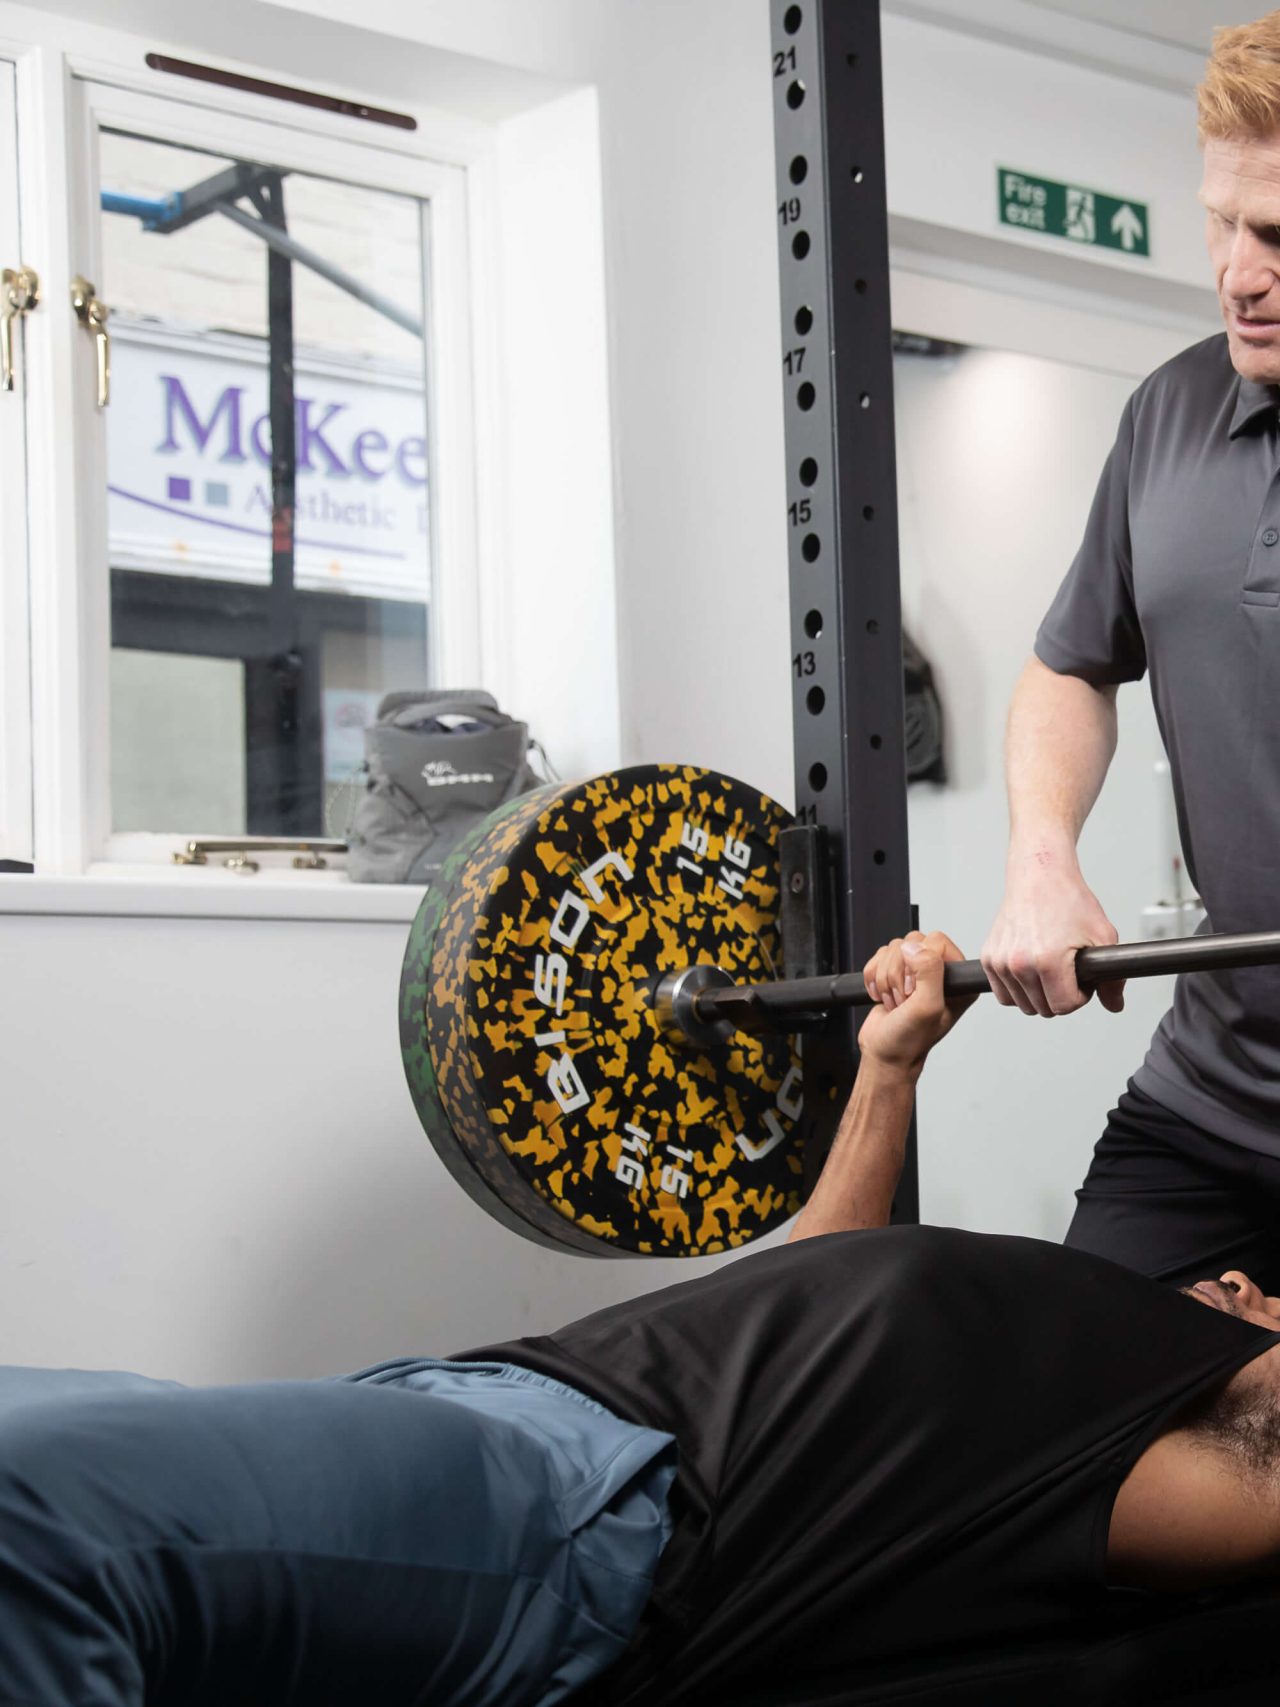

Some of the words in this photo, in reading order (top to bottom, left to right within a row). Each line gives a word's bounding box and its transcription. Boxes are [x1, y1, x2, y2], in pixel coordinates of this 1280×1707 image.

[773, 46, 797, 77] 21
[1004, 173, 1047, 206] Fire
[778, 197, 801, 226] 19
[1005, 202, 1046, 230] exit
[784, 346, 806, 376] 17
[788, 498, 812, 527] 15
[792, 651, 816, 678] 13
[676, 822, 709, 876] 15
[718, 834, 752, 900] KG
[534, 851, 634, 1114] BISON
[615, 1122, 652, 1190] KG
[660, 1144, 694, 1199] 15
